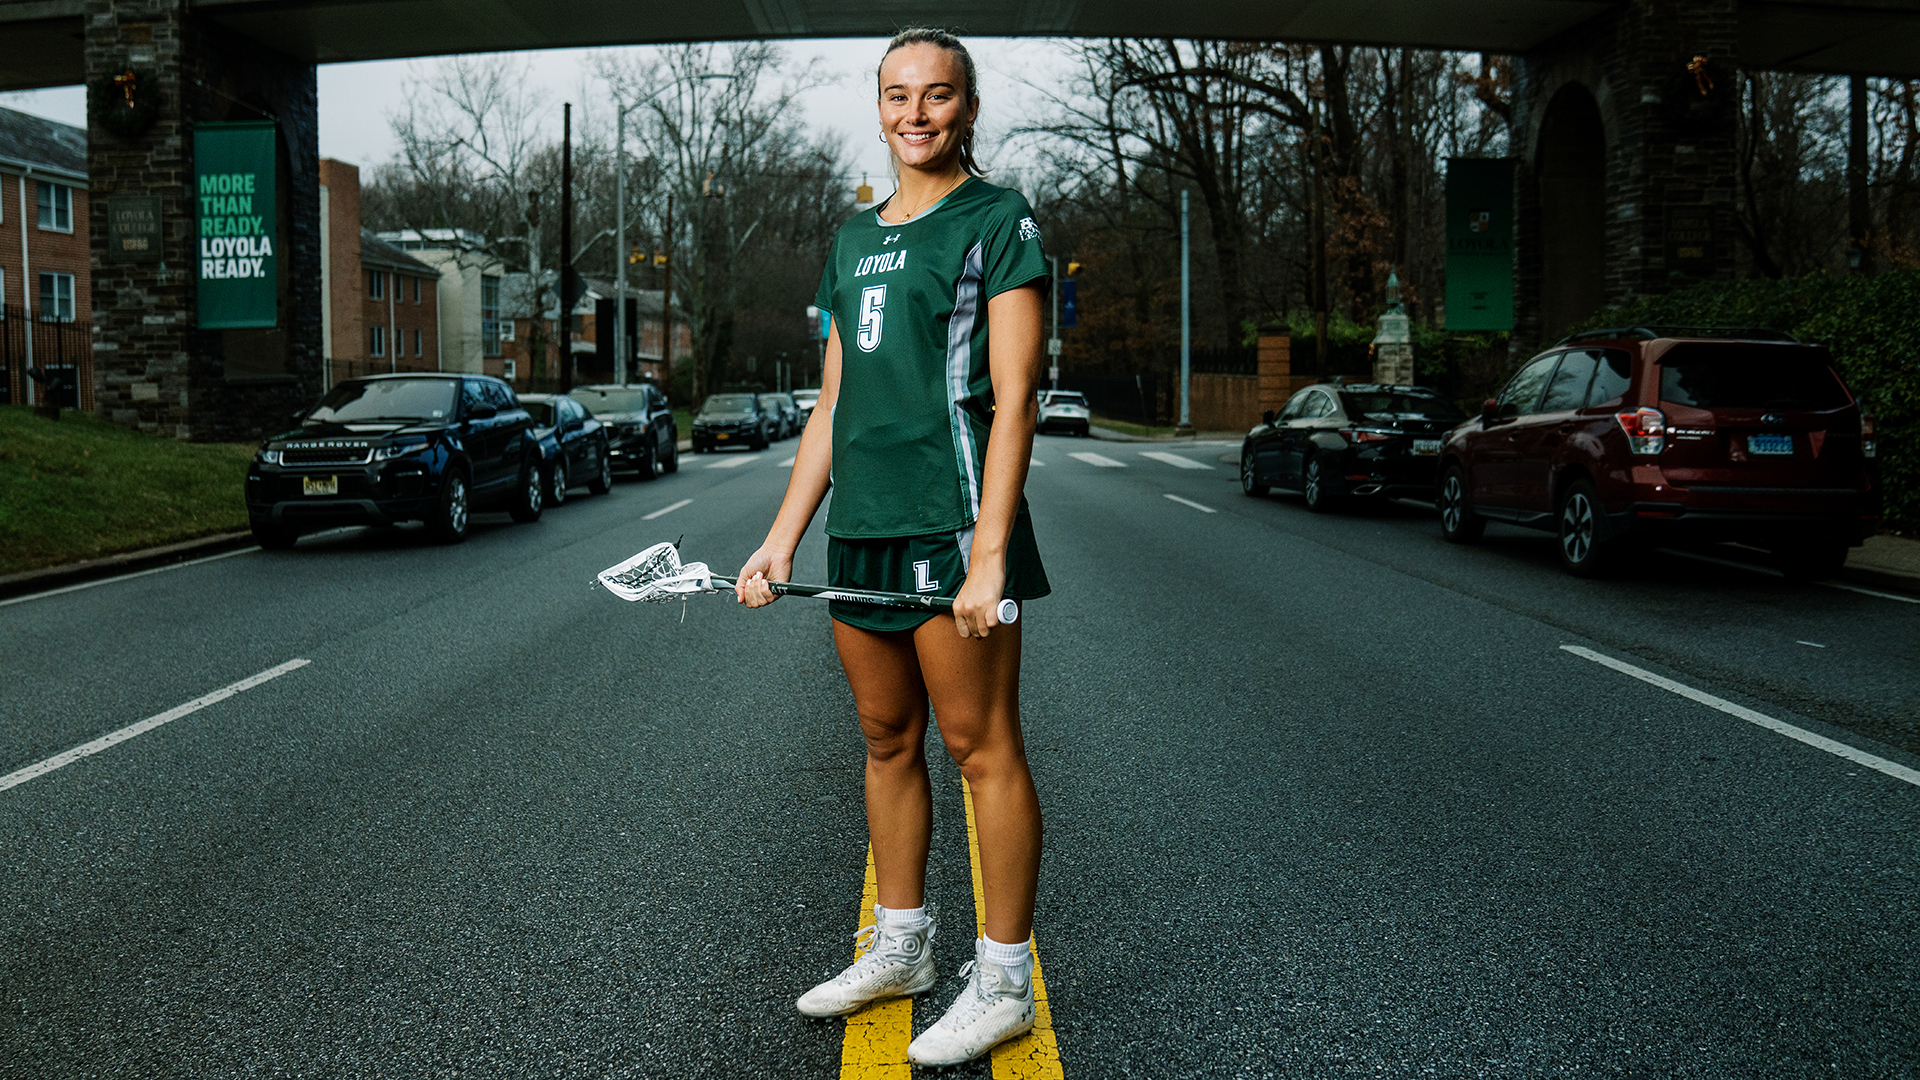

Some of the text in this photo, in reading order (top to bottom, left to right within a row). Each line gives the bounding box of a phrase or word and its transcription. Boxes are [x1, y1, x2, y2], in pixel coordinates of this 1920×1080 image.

[200, 174, 255, 195] MORE
[200, 196, 252, 216] THAN
[201, 216, 265, 236] READY.
[201, 235, 272, 258] LOYOLA
[1449, 238, 1509, 251] LOYOLA
[202, 258, 265, 279] READY.
[854, 249, 907, 277] LOYOLA
[857, 284, 887, 353] 5
[286, 440, 368, 449] RANGE ROVER
[913, 559, 939, 593] L
